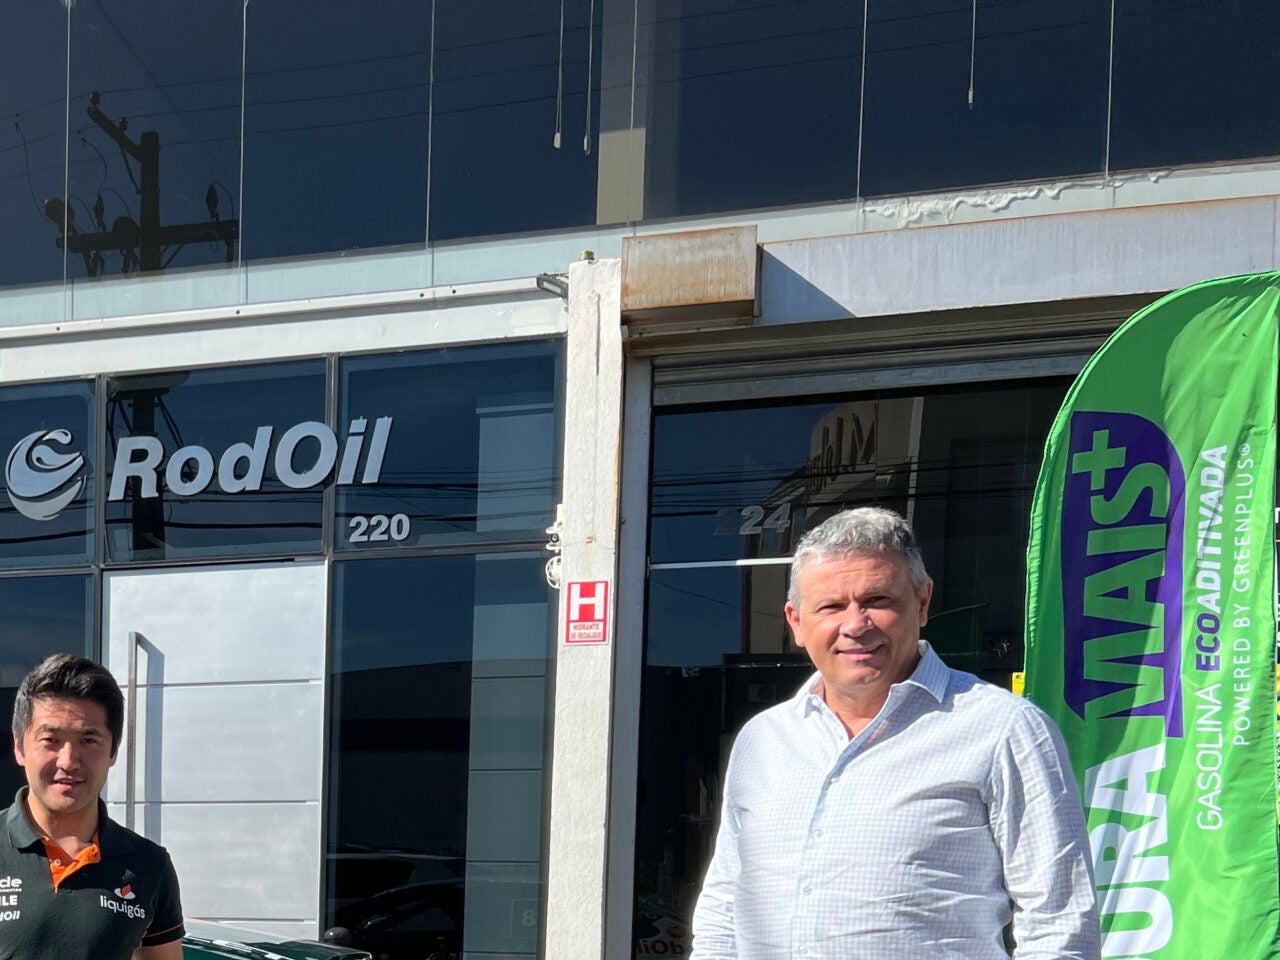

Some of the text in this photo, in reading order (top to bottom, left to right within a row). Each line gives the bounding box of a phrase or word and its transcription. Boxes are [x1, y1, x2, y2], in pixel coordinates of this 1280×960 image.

[108, 416, 392, 500] RodOil
[349, 514, 410, 543] 220
[1233, 602, 1251, 632] BY
[1233, 637, 1251, 746] POWERED
[1196, 683, 1223, 831] GASOLINA
[100, 895, 146, 919] liquigás
